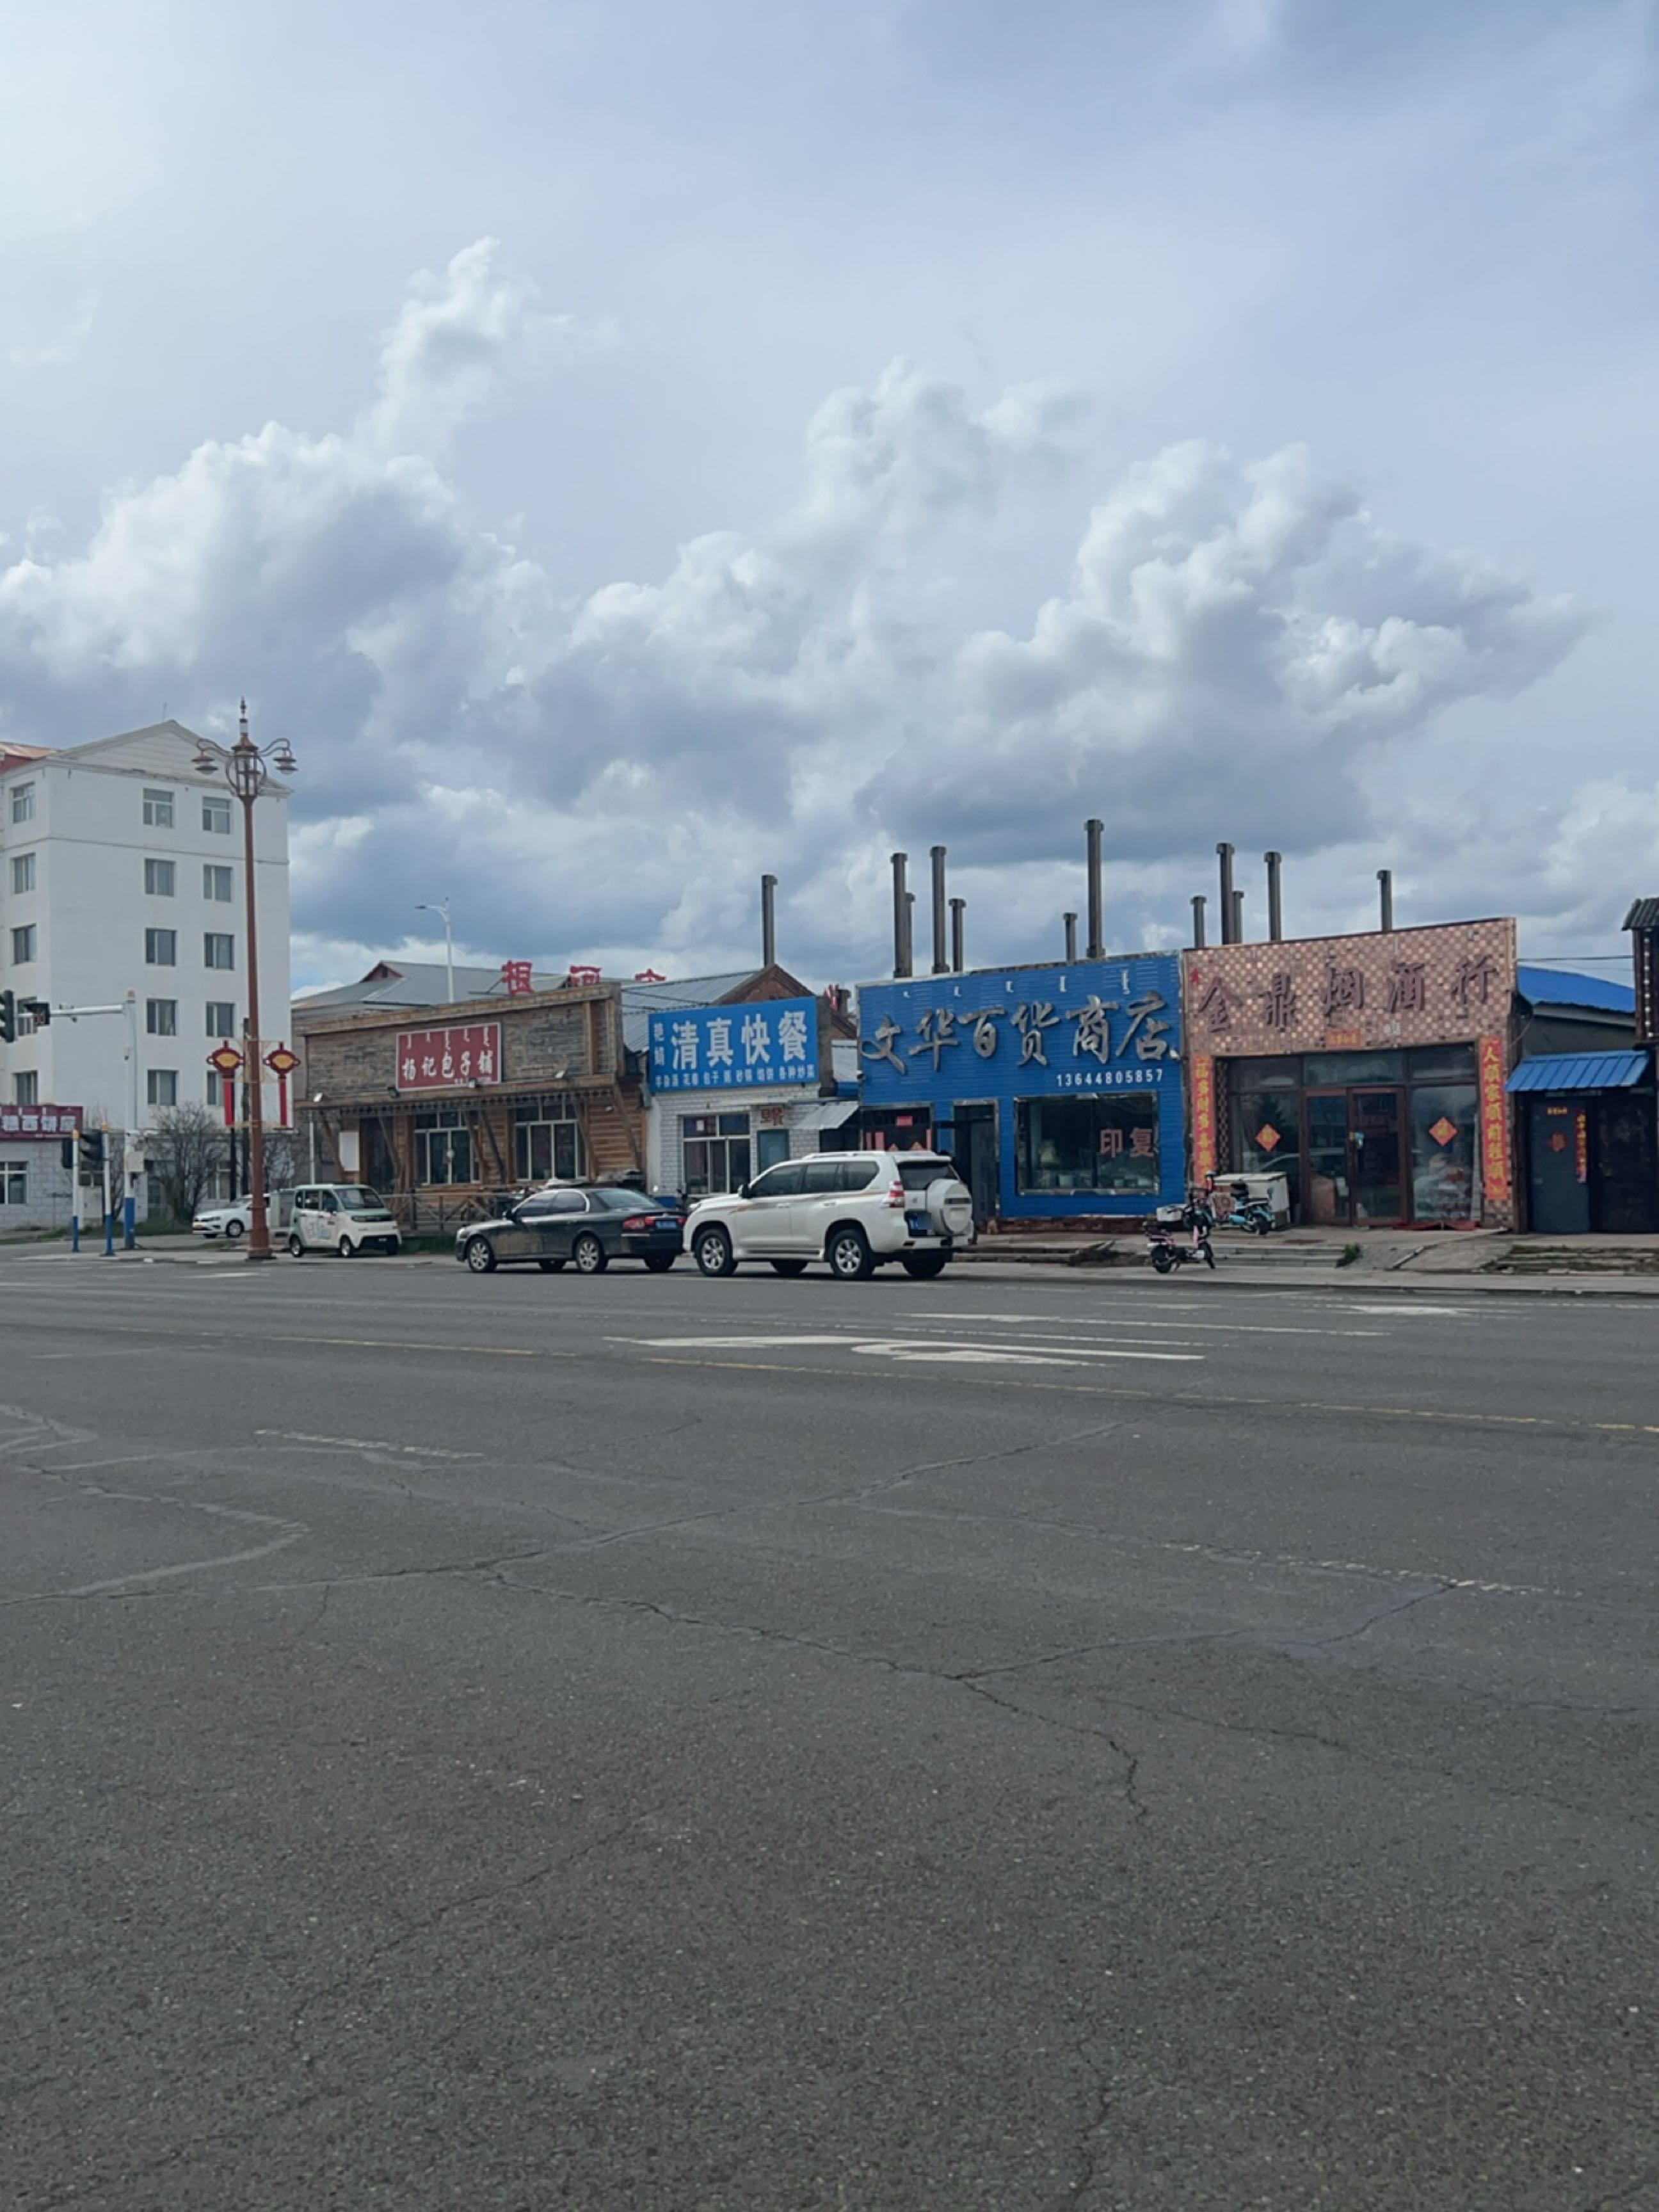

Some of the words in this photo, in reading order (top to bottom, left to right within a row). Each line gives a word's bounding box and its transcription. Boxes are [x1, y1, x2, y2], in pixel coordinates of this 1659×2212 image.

[1198, 955, 1499, 1033] 金鼎烟酒行
[671, 1011, 807, 1070] 清真快餐
[862, 991, 1169, 1075] 文华百货商店
[1057, 1069, 1162, 1087] 13644805857
